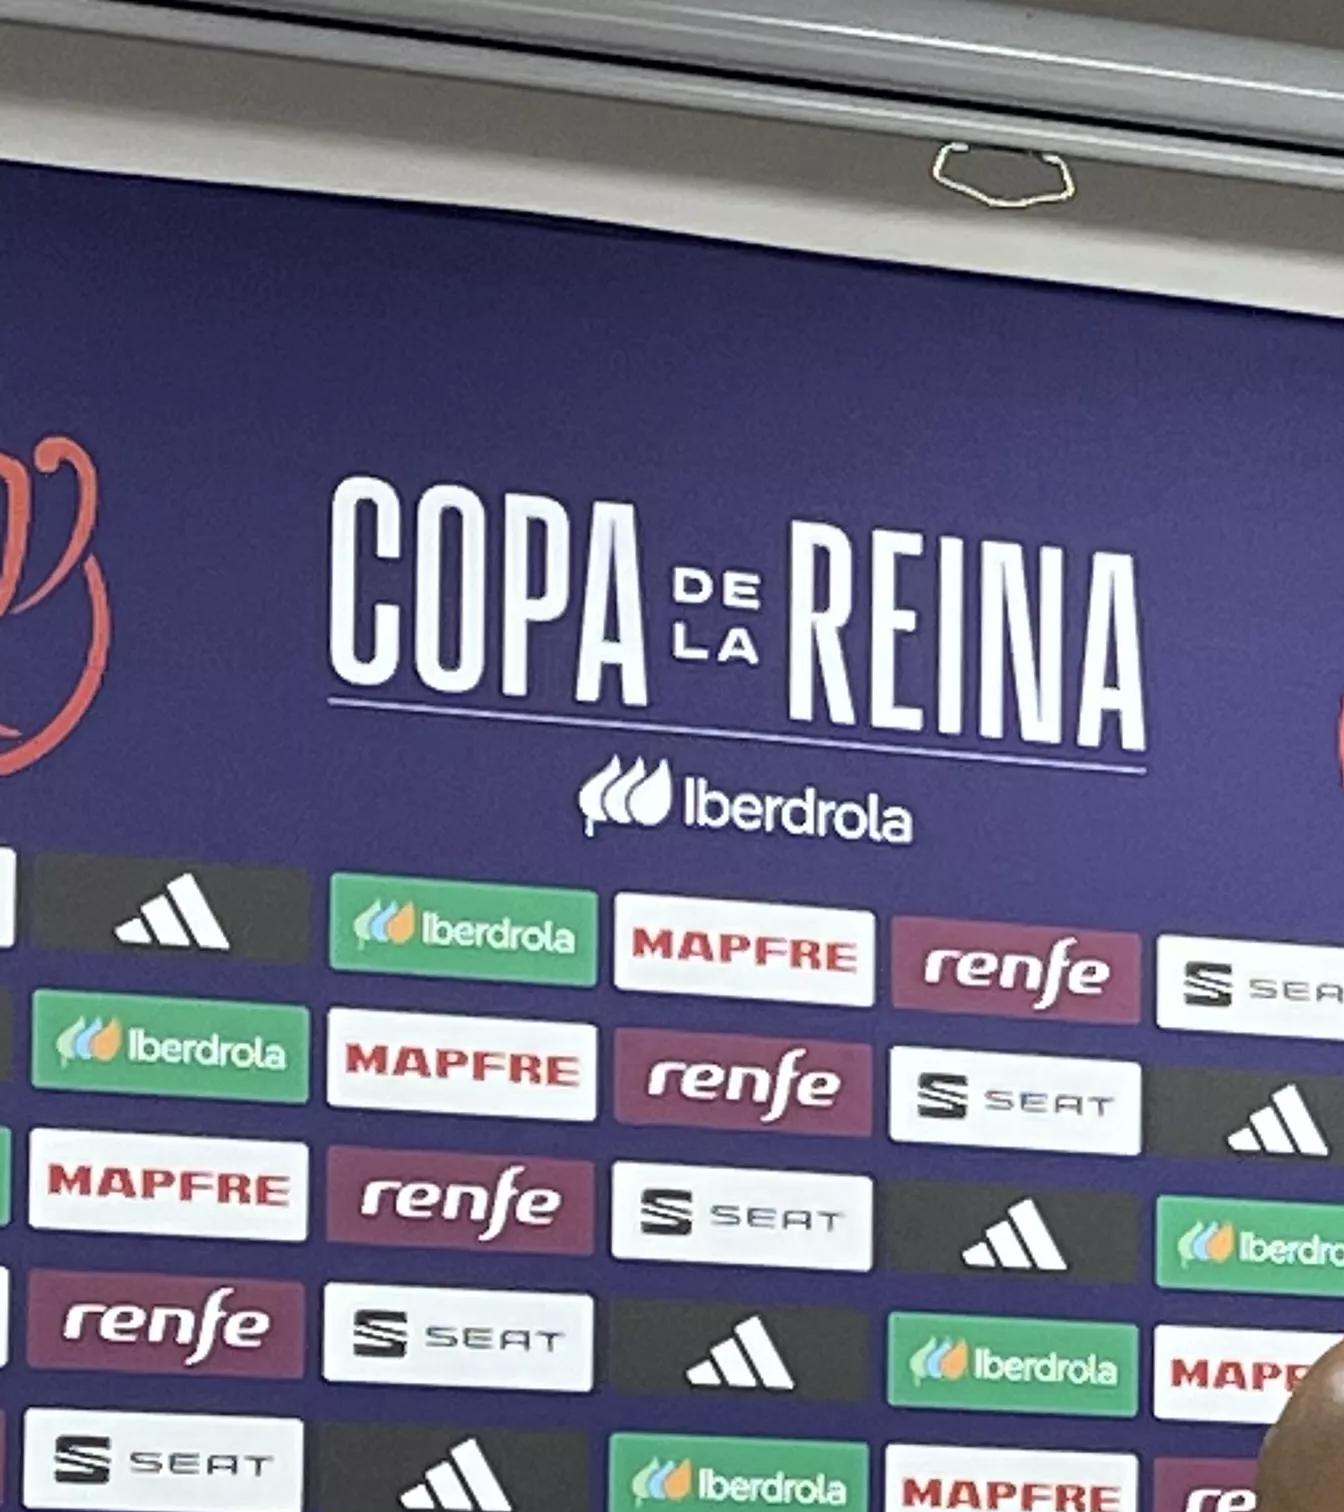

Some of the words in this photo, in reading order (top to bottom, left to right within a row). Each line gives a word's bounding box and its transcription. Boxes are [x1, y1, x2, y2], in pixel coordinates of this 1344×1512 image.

[329, 475, 648, 706] COPA
[674, 568, 760, 609] DE
[674, 623, 758, 664] LA
[789, 519, 1147, 751] REINA
[686, 778, 912, 842] Iberdrola
[423, 912, 574, 953] Iberdrola
[633, 928, 855, 972] MAPFRE
[926, 937, 1109, 1009] renfe
[129, 1028, 285, 1069] Iberdrola
[346, 1044, 576, 1086] MAPFRE
[649, 1049, 840, 1121] renfe
[985, 1091, 1113, 1116] SEAT
[49, 1164, 288, 1206] MAPFRE
[362, 1166, 560, 1240] renfe
[711, 1205, 839, 1231] SEAT
[64, 1288, 269, 1365] renfe
[426, 1327, 562, 1352] SEAT
[975, 1348, 1117, 1384] Iberdrola
[1171, 1359, 1313, 1391] MAPF
[130, 1452, 269, 1476] SEAT
[699, 1468, 846, 1505] Iberdrola
